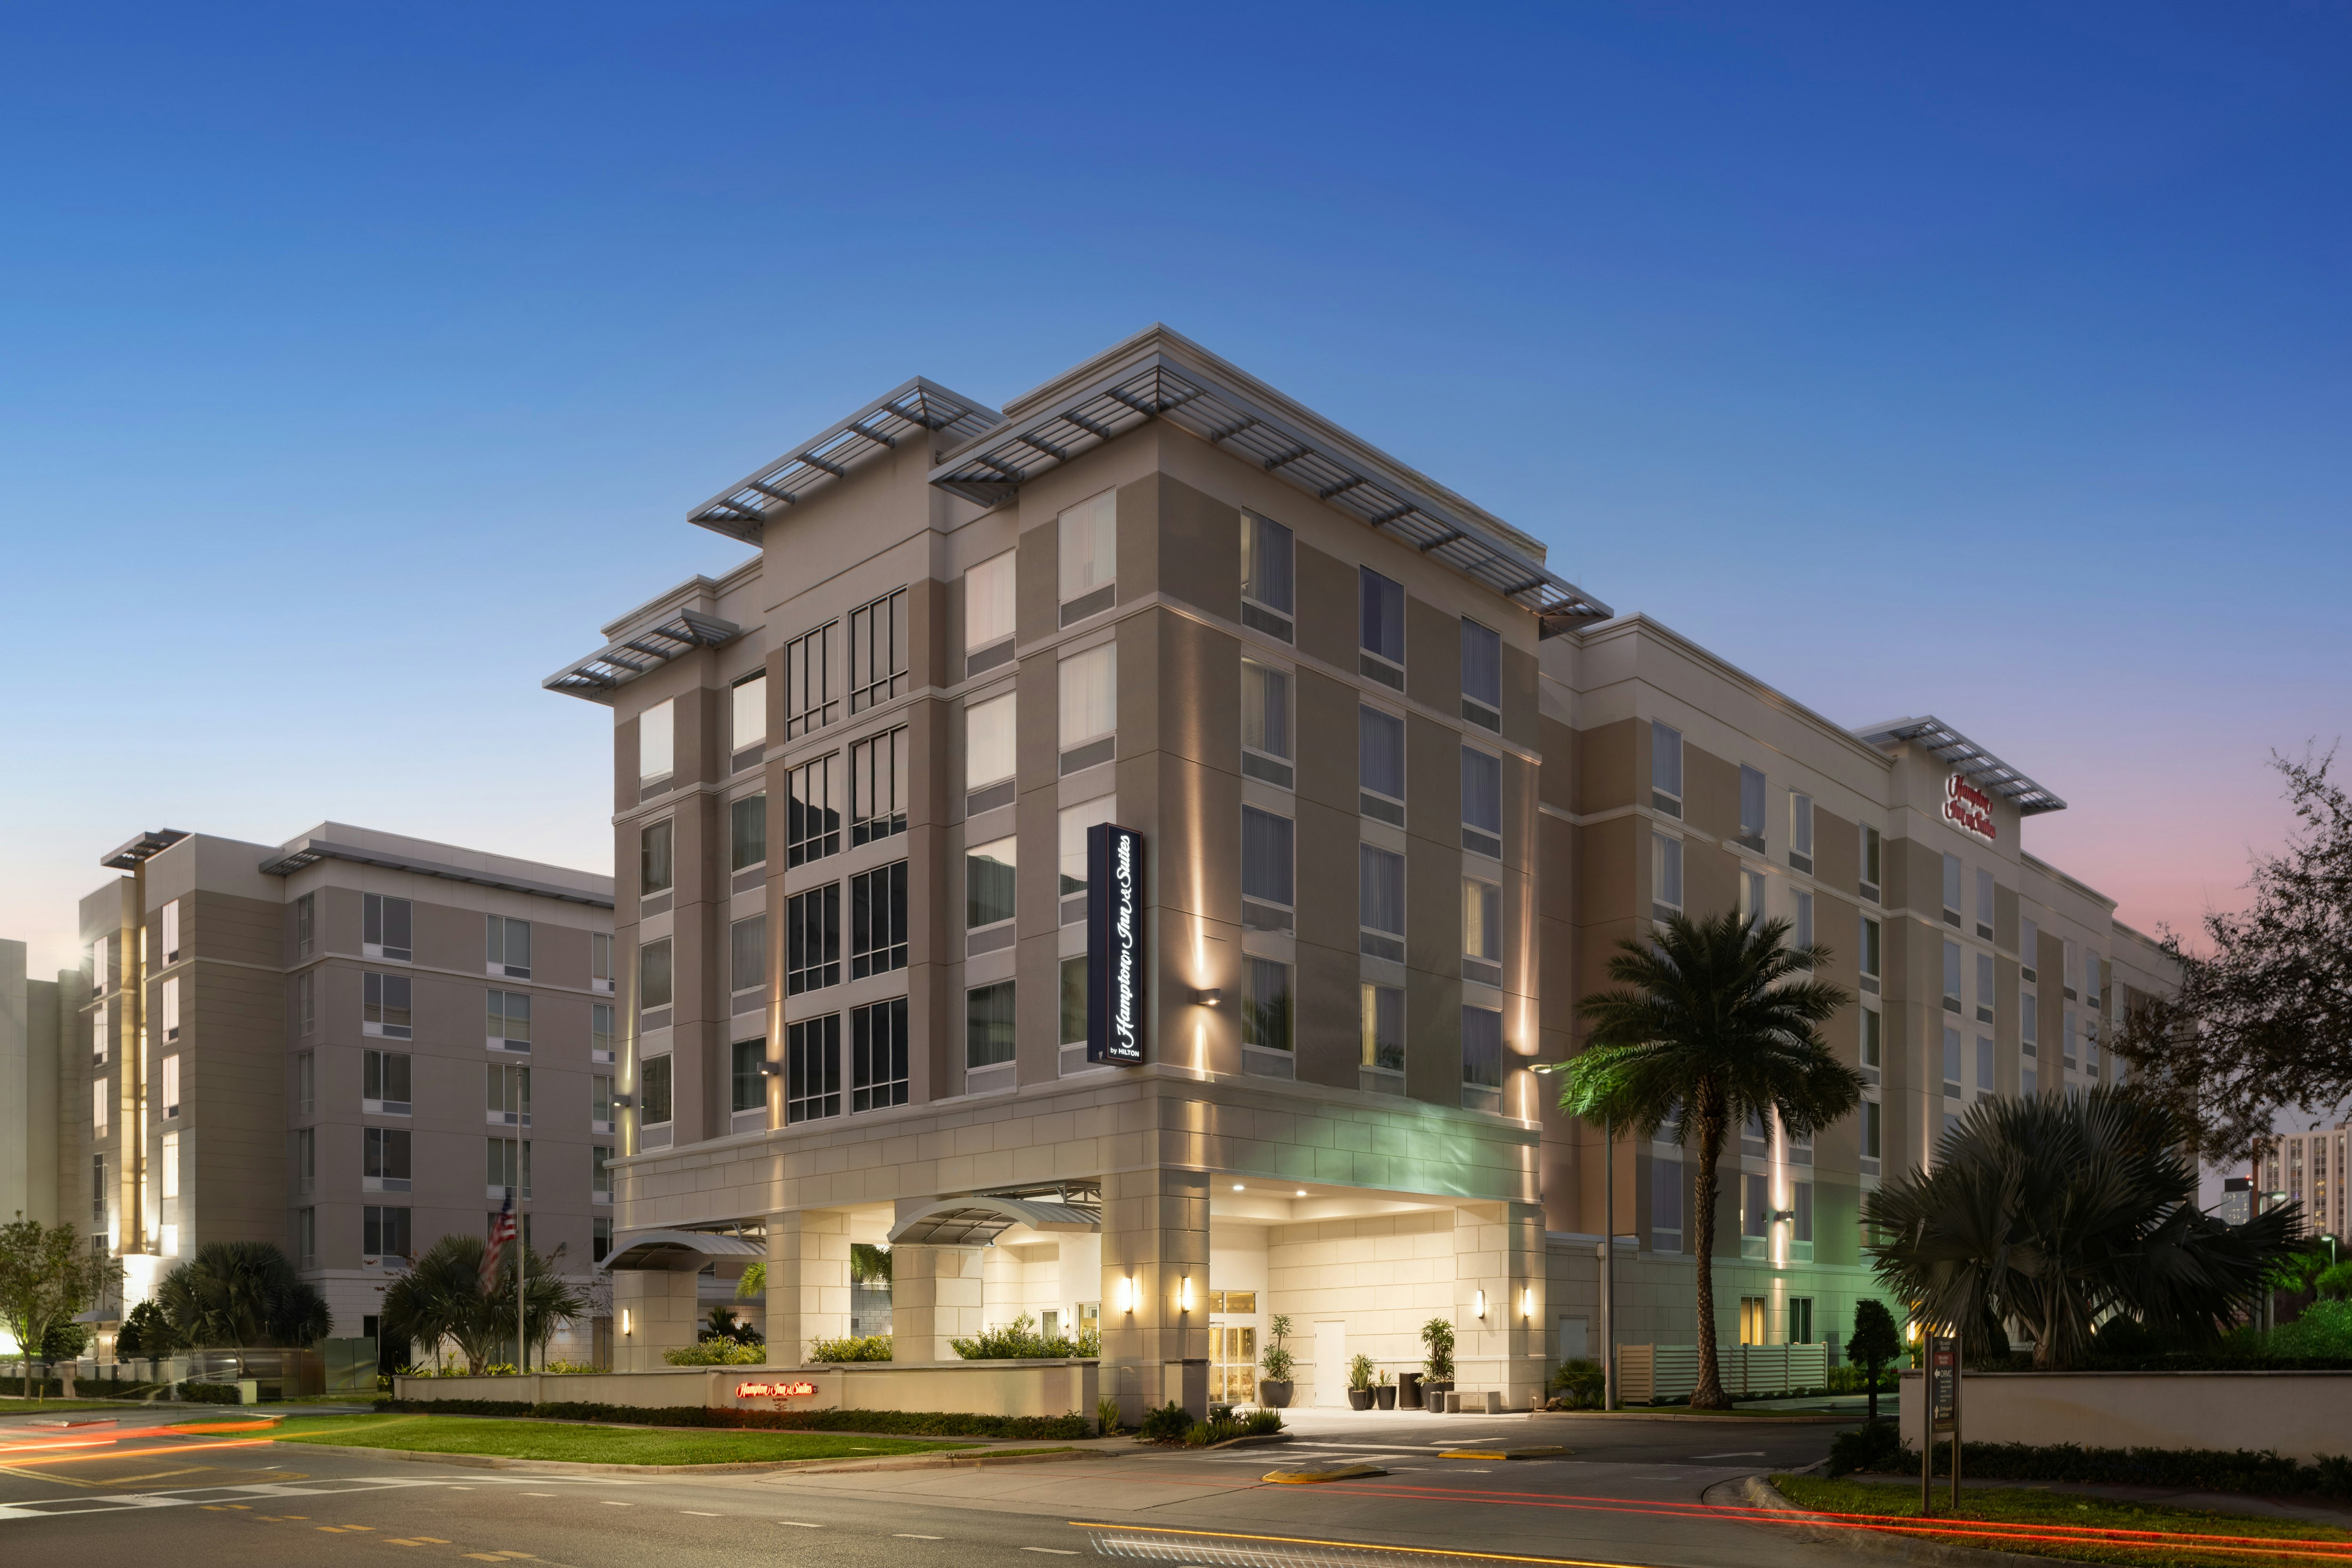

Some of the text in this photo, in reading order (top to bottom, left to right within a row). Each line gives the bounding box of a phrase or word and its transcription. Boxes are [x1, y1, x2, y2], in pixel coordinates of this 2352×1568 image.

[1948, 775, 1993, 815] Hampton
[1115, 835, 1134, 1049] Hampton Inn & Suites
[1118, 1048, 1139, 1057] HILTON
[736, 1382, 771, 1398] Hampton
[771, 1383, 789, 1396] Inn
[792, 1382, 812, 1394] Suites
